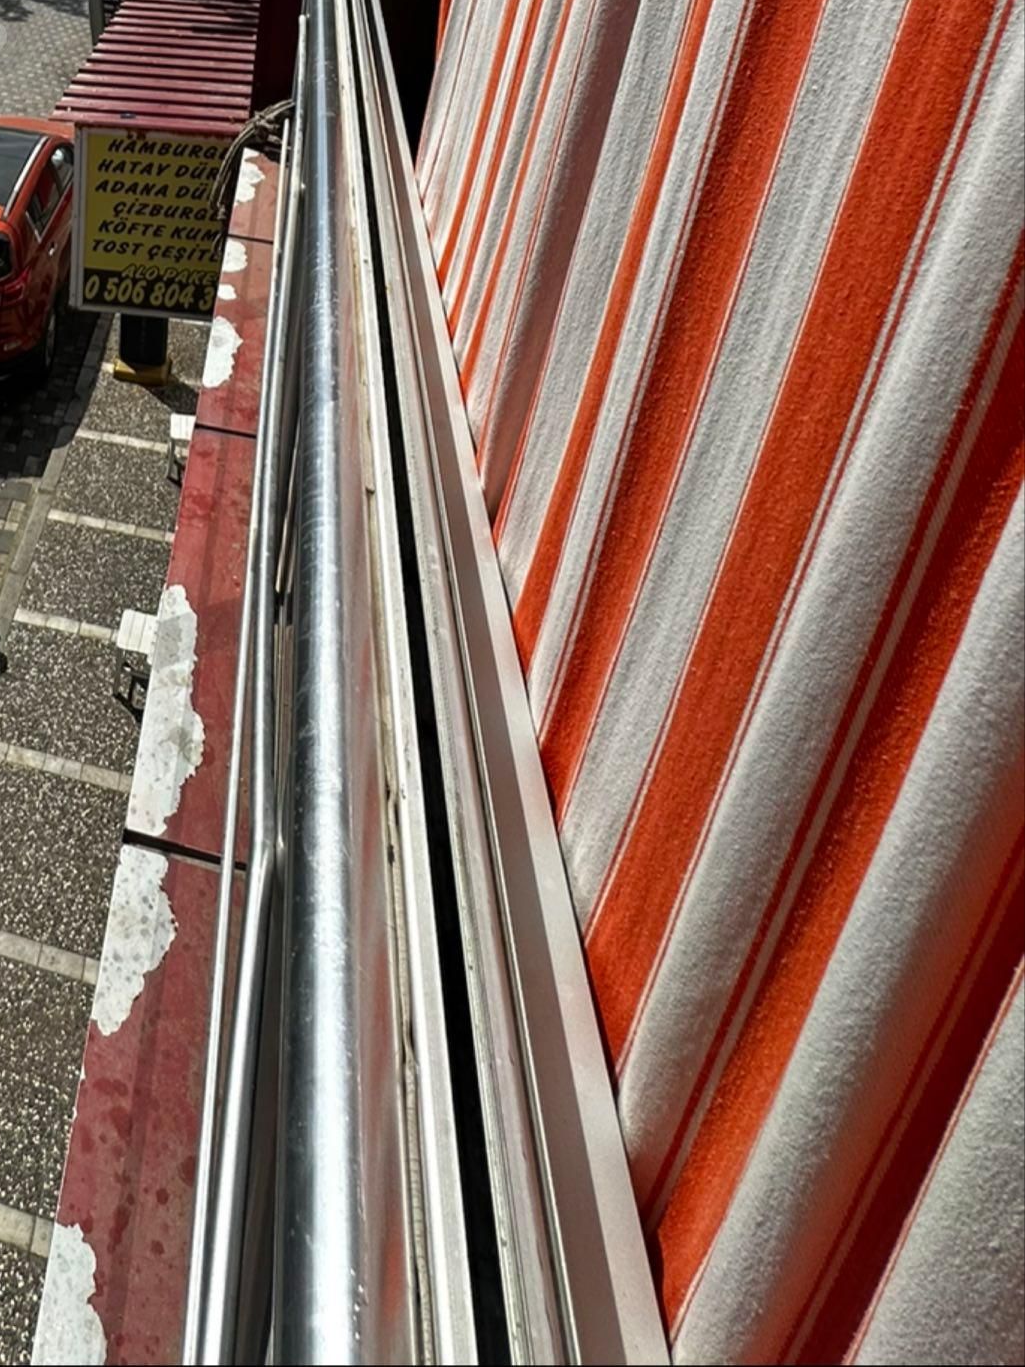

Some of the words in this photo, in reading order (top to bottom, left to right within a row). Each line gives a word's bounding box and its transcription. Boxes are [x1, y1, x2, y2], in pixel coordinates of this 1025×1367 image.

[98, 159, 170, 176] HATAY
[175, 162, 219, 180] DÜR
[95, 180, 168, 197] ADANA
[176, 183, 210, 201] DÜ
[98, 217, 166, 237] KÖFTE
[92, 239, 144, 255] TOST
[121, 264, 160, 280] ALO
[163, 268, 218, 286] PAKE
[84, 274, 101, 300] 0
[104, 277, 147, 304] 506
[149, 281, 195, 310] 804
[198, 285, 215, 311] 3
